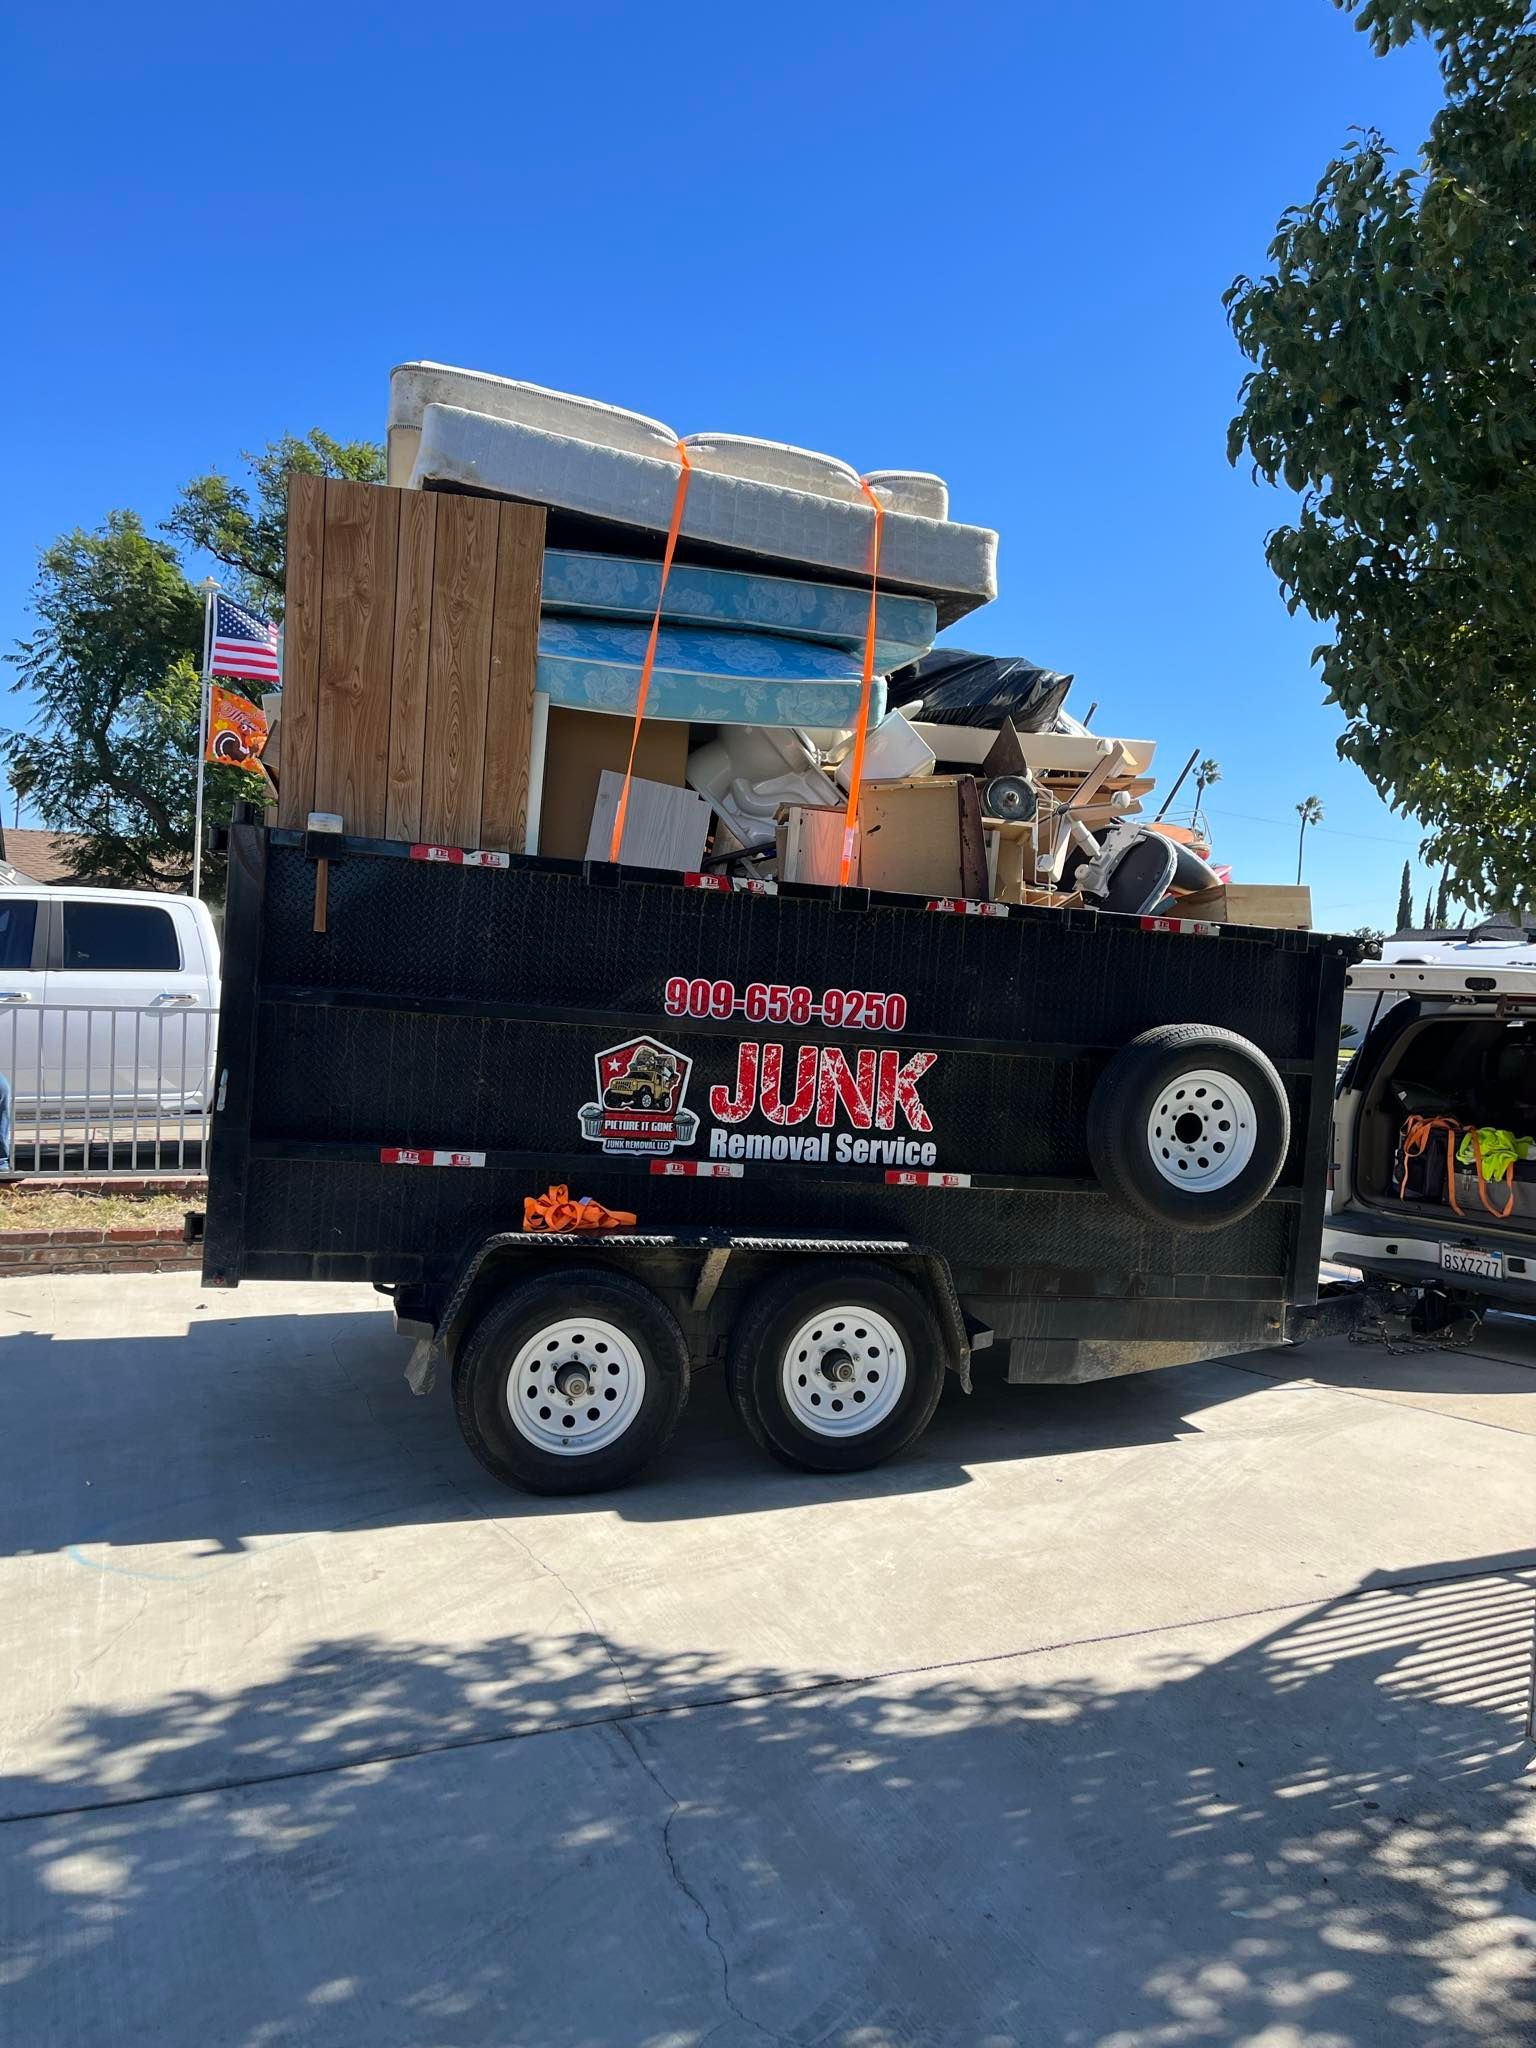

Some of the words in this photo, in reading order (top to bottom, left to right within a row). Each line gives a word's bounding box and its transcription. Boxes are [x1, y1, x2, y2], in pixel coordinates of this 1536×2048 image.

[664, 976, 908, 1032] 909-658-9250
[710, 1042, 938, 1133] JUNK
[604, 1120, 640, 1131] PICTURE
[641, 1121, 650, 1132] IT
[651, 1122, 674, 1133] GONE
[606, 1140, 625, 1149] JUNK
[625, 1140, 657, 1150] REMOVAL
[657, 1142, 669, 1151] LLC
[709, 1128, 831, 1163] Removal
[835, 1132, 938, 1167] Service
[1444, 1254, 1498, 1277] 8SXZ277
